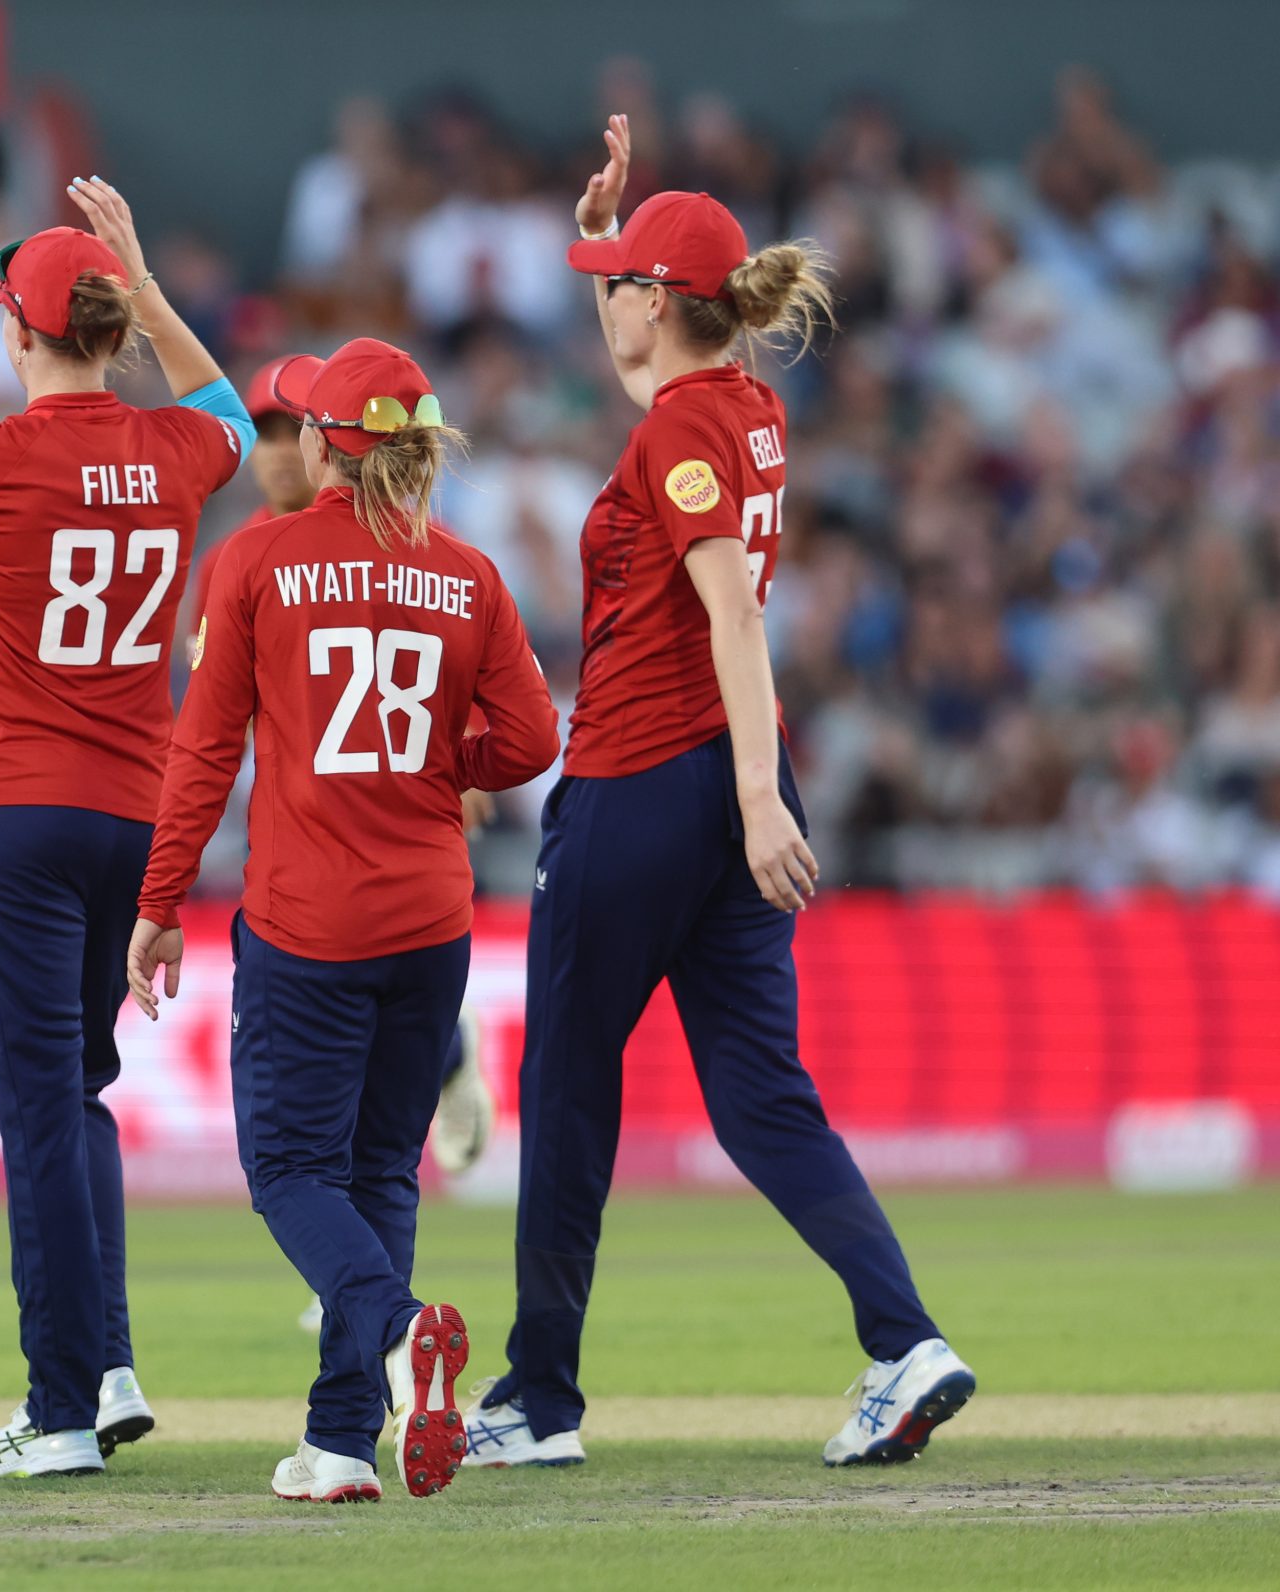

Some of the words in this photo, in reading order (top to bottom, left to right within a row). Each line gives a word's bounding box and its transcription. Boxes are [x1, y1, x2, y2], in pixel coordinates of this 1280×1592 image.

[651, 263, 669, 277] 57
[80, 464, 160, 506] FILER
[675, 468, 705, 492] HULA
[681, 481, 715, 508] HOOPS
[740, 484, 786, 608] 6
[37, 528, 180, 666] 82
[273, 560, 475, 620] WYATT-HODGE
[308, 626, 443, 775] 28
